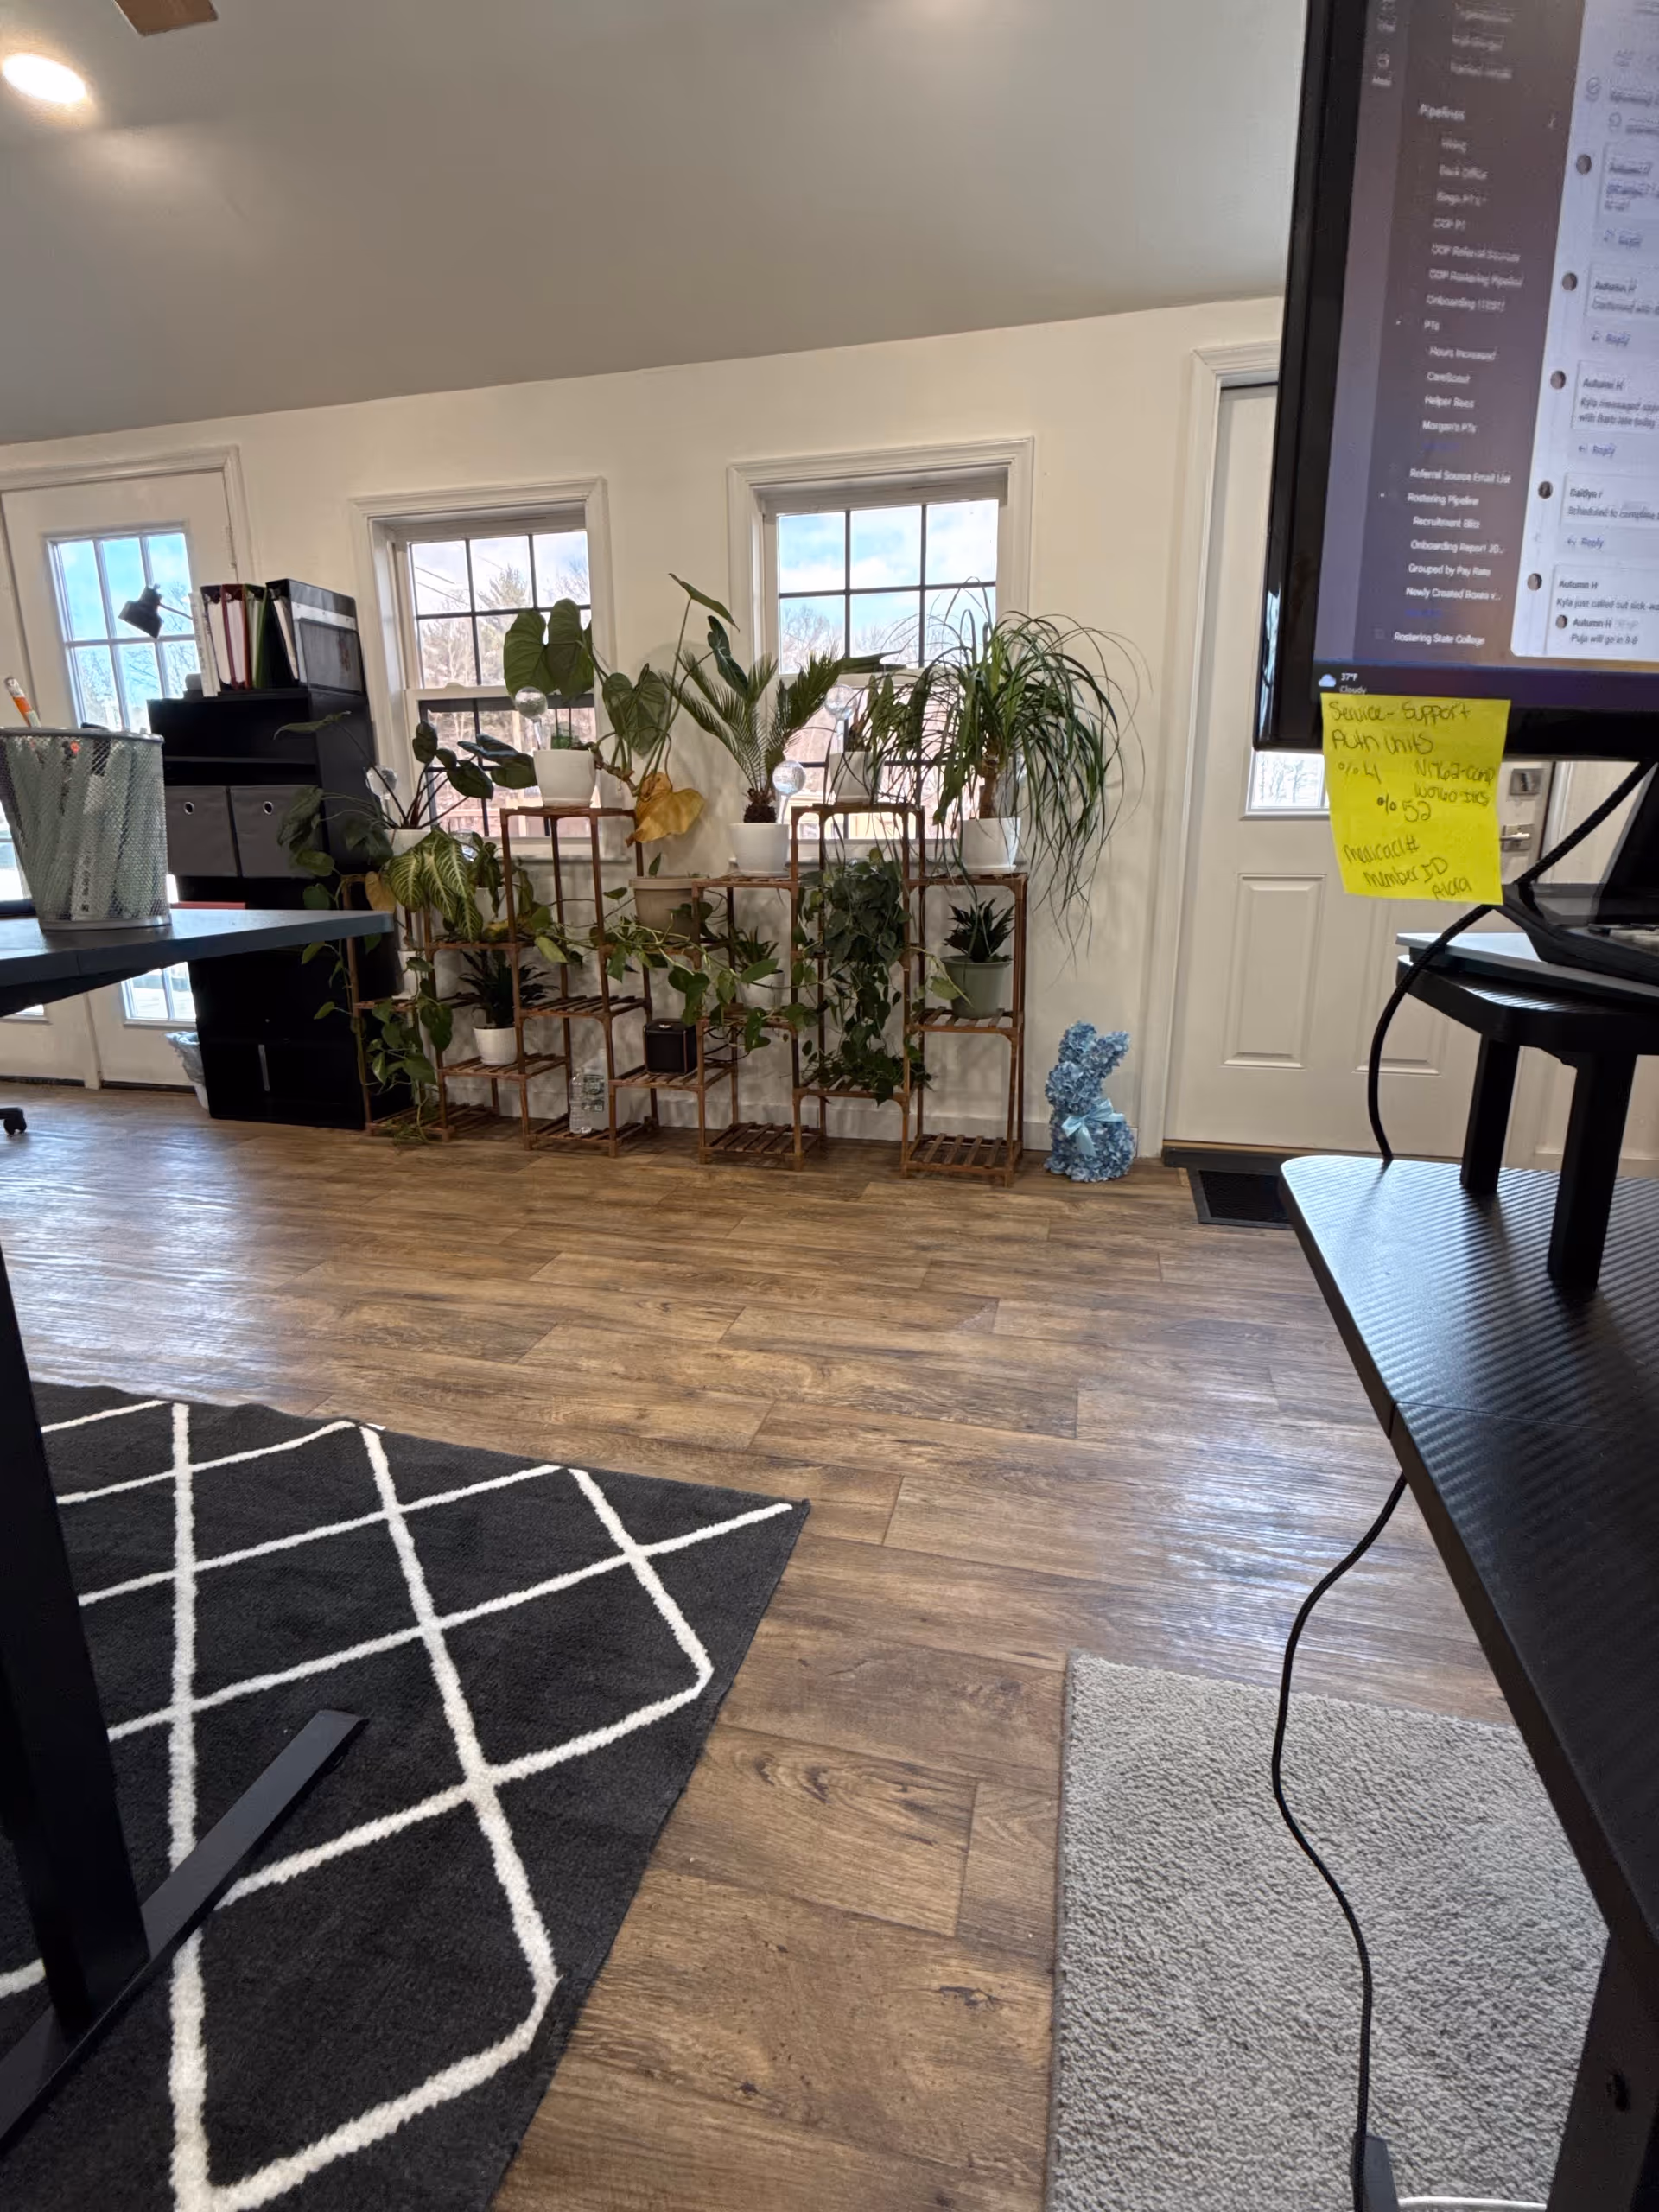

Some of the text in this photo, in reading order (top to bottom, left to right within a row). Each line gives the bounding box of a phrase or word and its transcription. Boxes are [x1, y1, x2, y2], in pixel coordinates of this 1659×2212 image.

[1409, 467, 1442, 480] Referral
[1443, 470, 1471, 481] Source
[1473, 473, 1496, 483] Email
[1407, 493, 1479, 506] Rostering Pipeline
[1410, 539, 1458, 553] Onboarding
[1580, 537, 1604, 549] Reply
[1408, 563, 1443, 575] Grouped
[1445, 565, 1455, 577] by
[1457, 566, 1471, 577] Pay
[1559, 580, 1590, 589] Autumn
[1406, 588, 1431, 599] Newly
[1432, 588, 1464, 599] Created
[1556, 598, 1573, 610] Kyla
[1574, 599, 1589, 609] just
[1592, 599, 1615, 609] called
[1573, 618, 1603, 627] Autumn
[1394, 632, 1485, 647] Rostering State College
[1591, 633, 1604, 643] will
[1605, 636, 1615, 645] go
[1617, 635, 1624, 644] in
[1341, 672, 1358, 682] 37°F
[1339, 684, 1367, 695] Cloudy
[1402, 701, 1471, 726] Support
[1332, 729, 1433, 754] Auth Units
[1363, 857, 1449, 887] Member ID
